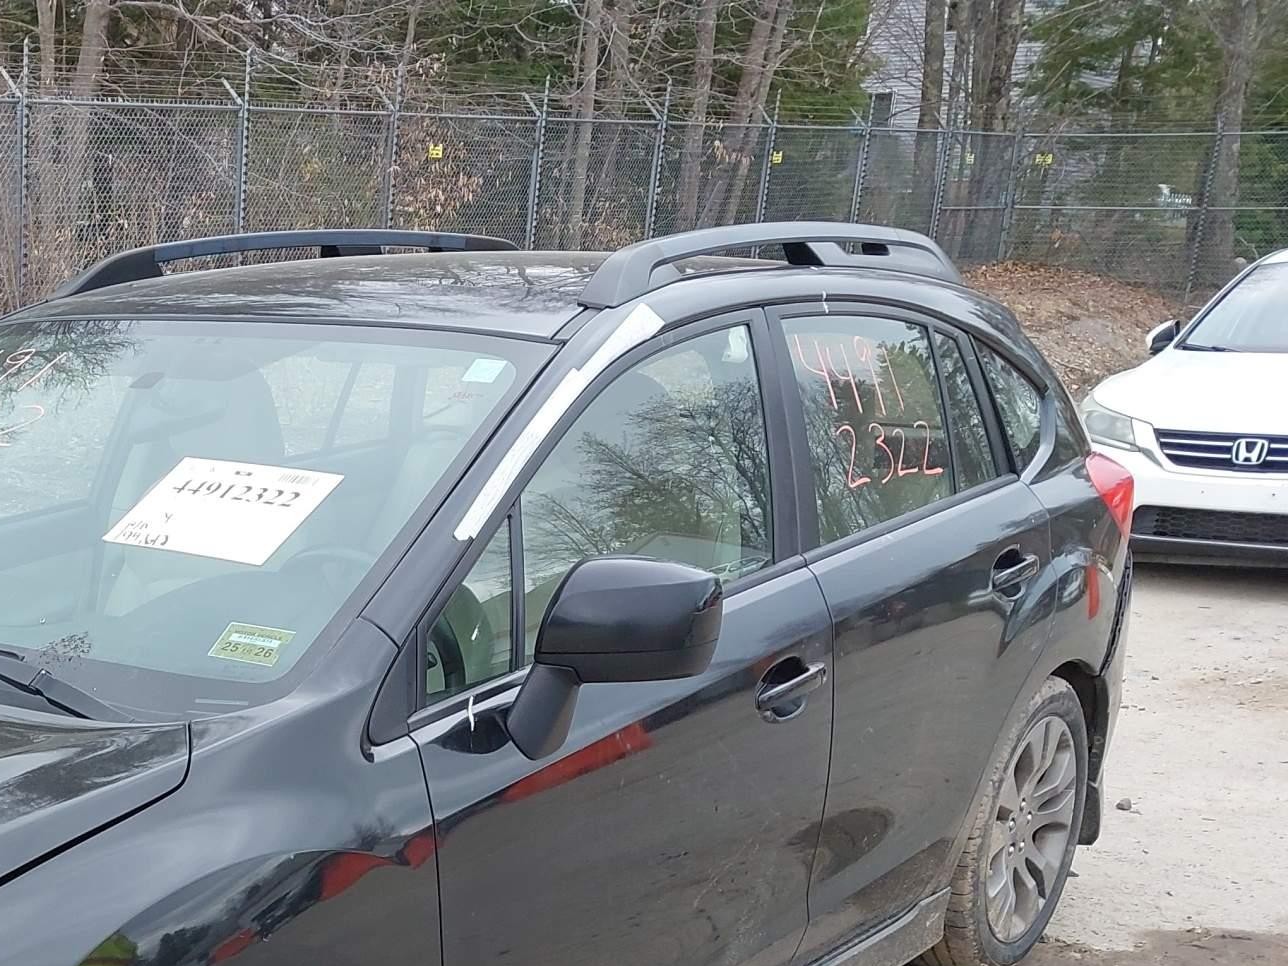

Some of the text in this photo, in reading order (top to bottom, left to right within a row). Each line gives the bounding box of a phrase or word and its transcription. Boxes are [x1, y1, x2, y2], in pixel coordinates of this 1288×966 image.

[788, 334, 904, 416] 4491
[836, 421, 944, 488] 2322
[172, 479, 301, 507] 44912322
[221, 641, 241, 653] 25
[254, 647, 274, 658] 26
